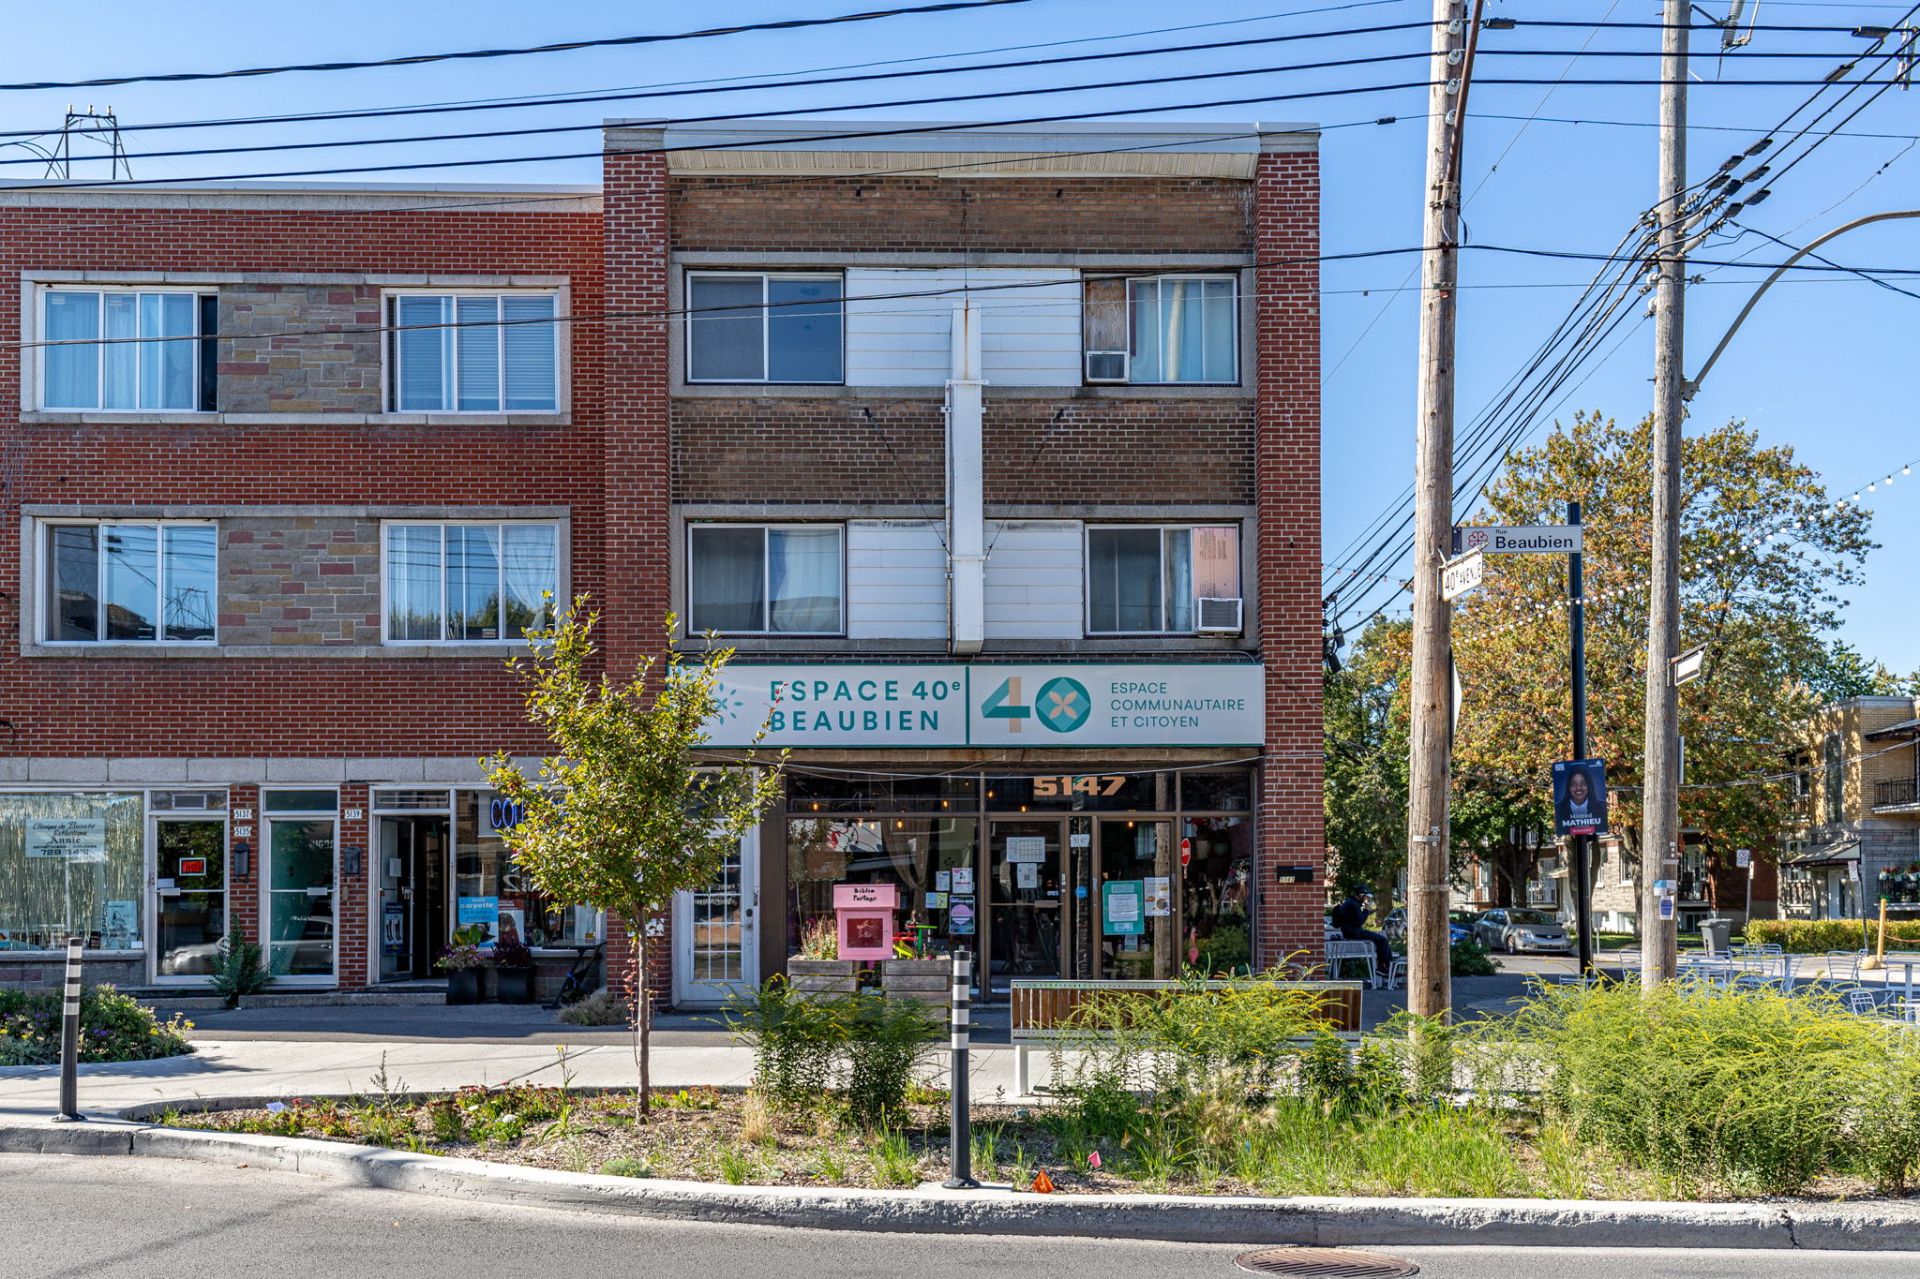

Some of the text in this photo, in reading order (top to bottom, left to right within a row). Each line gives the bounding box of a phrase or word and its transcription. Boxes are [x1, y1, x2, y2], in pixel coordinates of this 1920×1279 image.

[1495, 536, 1573, 549] Beaubien
[770, 680, 898, 701] ESPACE
[1110, 682, 1168, 694] ESPACE
[1110, 699, 1245, 711] COMMUNAUTAIRE
[770, 710, 939, 731] BEAUBIEN
[1110, 716, 1199, 728] ET CITOYEN
[1033, 776, 1126, 796] 5147
[235, 809, 250, 818] 5137
[345, 809, 361, 818] 5139
[1562, 817, 1601, 827] MATHIEU
[235, 827, 251, 835] 5135
[47, 836, 81, 845] Annie
